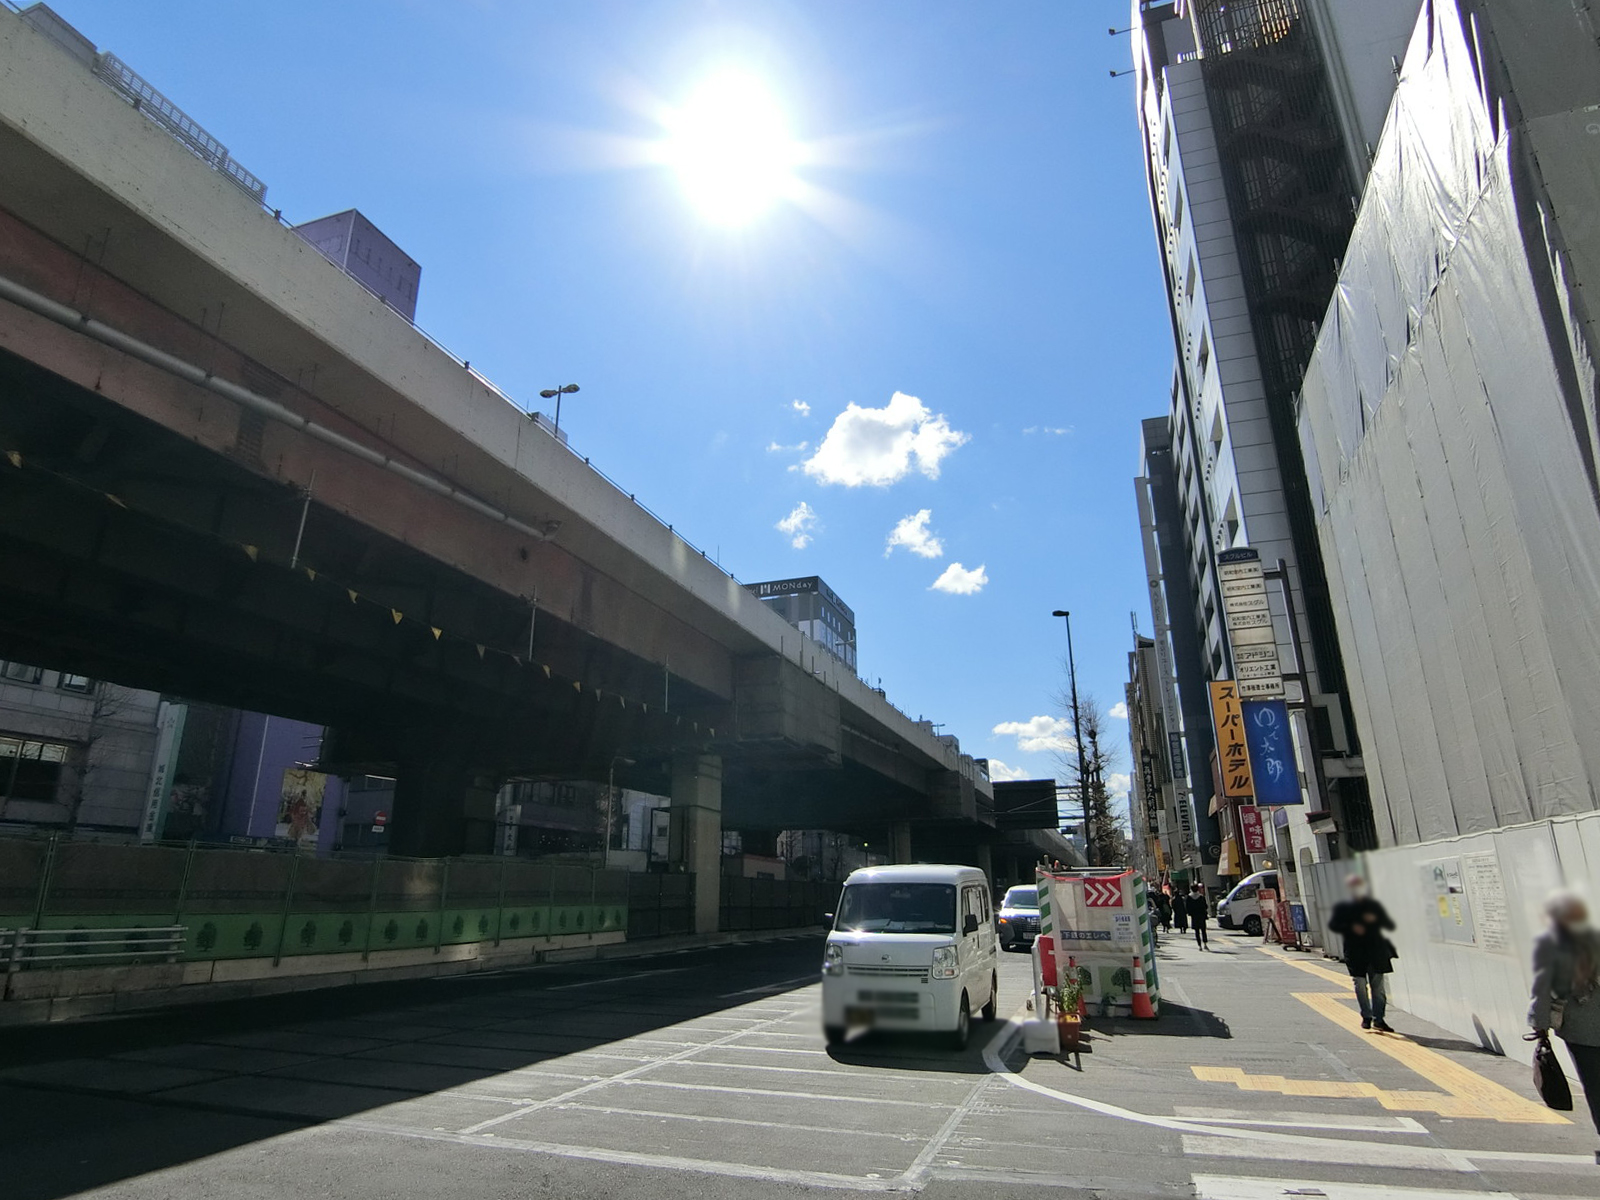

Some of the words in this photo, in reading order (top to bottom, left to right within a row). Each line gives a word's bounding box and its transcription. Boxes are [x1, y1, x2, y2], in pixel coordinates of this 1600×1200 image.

[772, 580, 813, 592] MONday
[1239, 664, 1277, 673] オリエント工業
[1218, 686, 1249, 790] スーパーホテル
[1253, 707, 1284, 784] ゆで太郎
